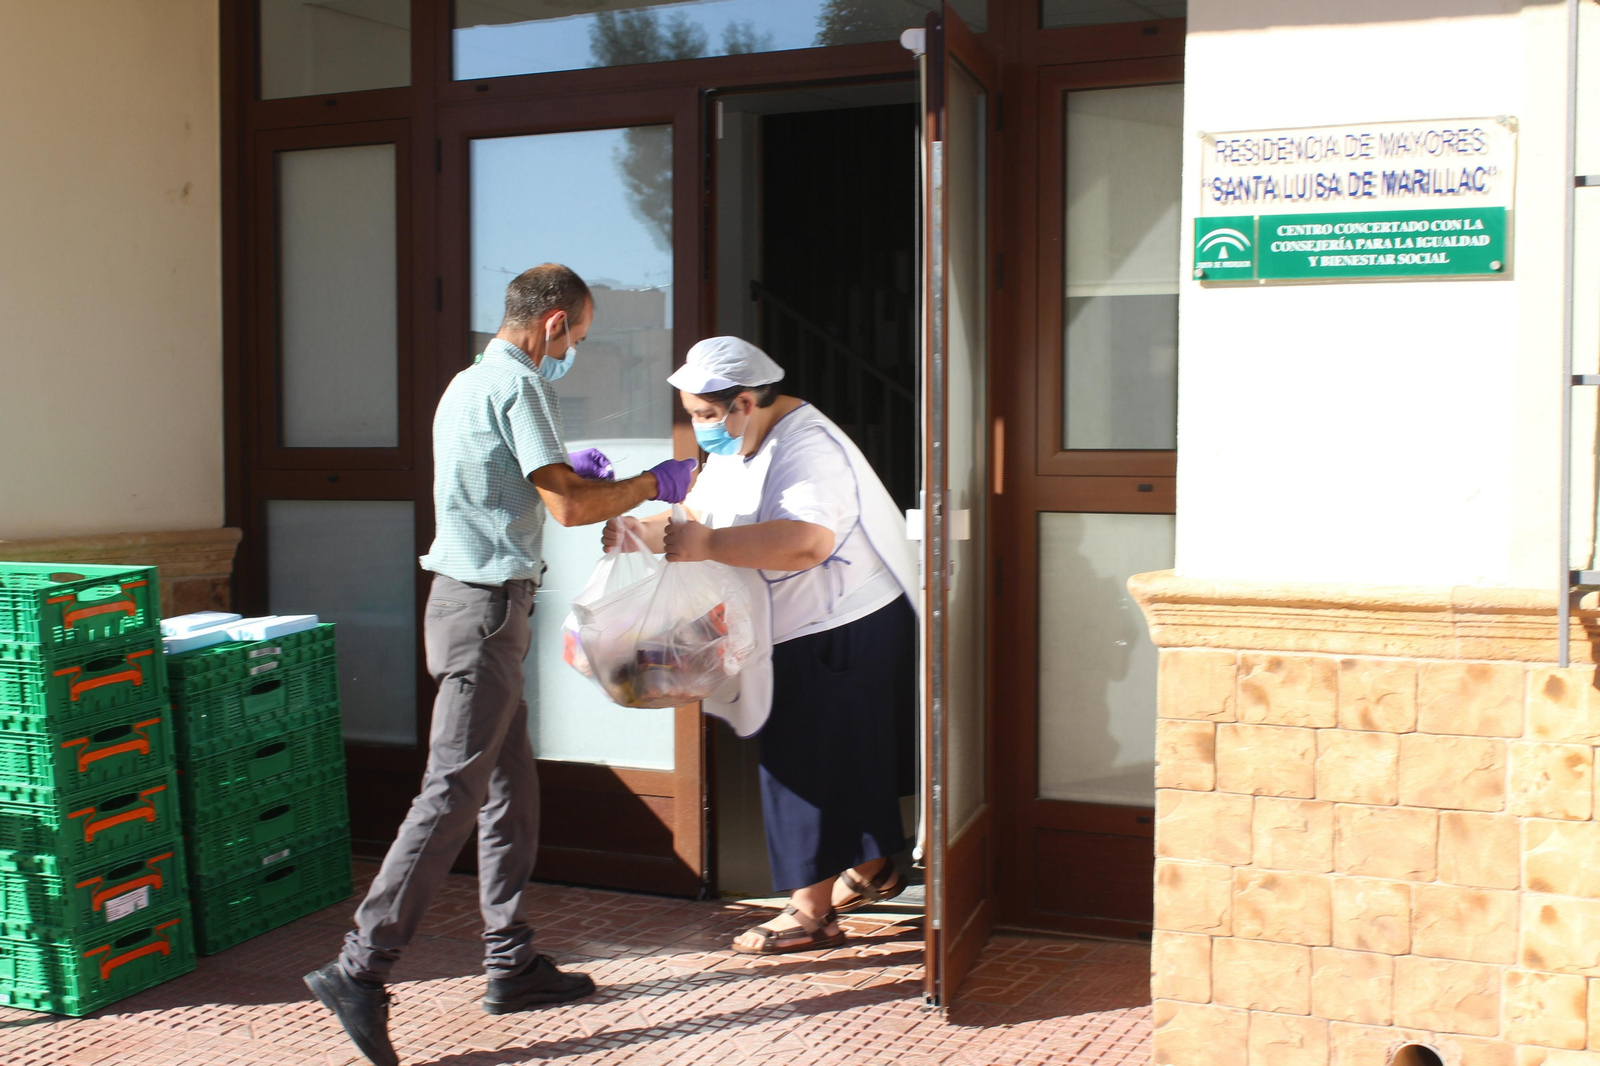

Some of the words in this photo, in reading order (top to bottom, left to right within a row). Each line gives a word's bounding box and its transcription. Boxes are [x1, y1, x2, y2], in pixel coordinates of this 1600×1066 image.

[1215, 134, 1337, 162] RESIDENCIA
[1345, 133, 1370, 157] DE
[1379, 128, 1485, 156] MAYORES
[1283, 172, 1340, 199] LUISA
[1349, 171, 1373, 196] DE
[1276, 223, 1333, 237] CENTRO
[1333, 220, 1430, 235] CONCERTADO
[1430, 219, 1463, 231] CON
[1463, 218, 1484, 231] LA
[1270, 236, 1354, 252] CONSEJERÍA
[1355, 238, 1394, 250] PARA
[1394, 237, 1415, 249] LA
[1415, 234, 1491, 248] IGUALDAD
[1308, 255, 1319, 267] Y
[1320, 254, 1396, 267] BIENESTAR
[1396, 252, 1450, 265] SOCIAL
